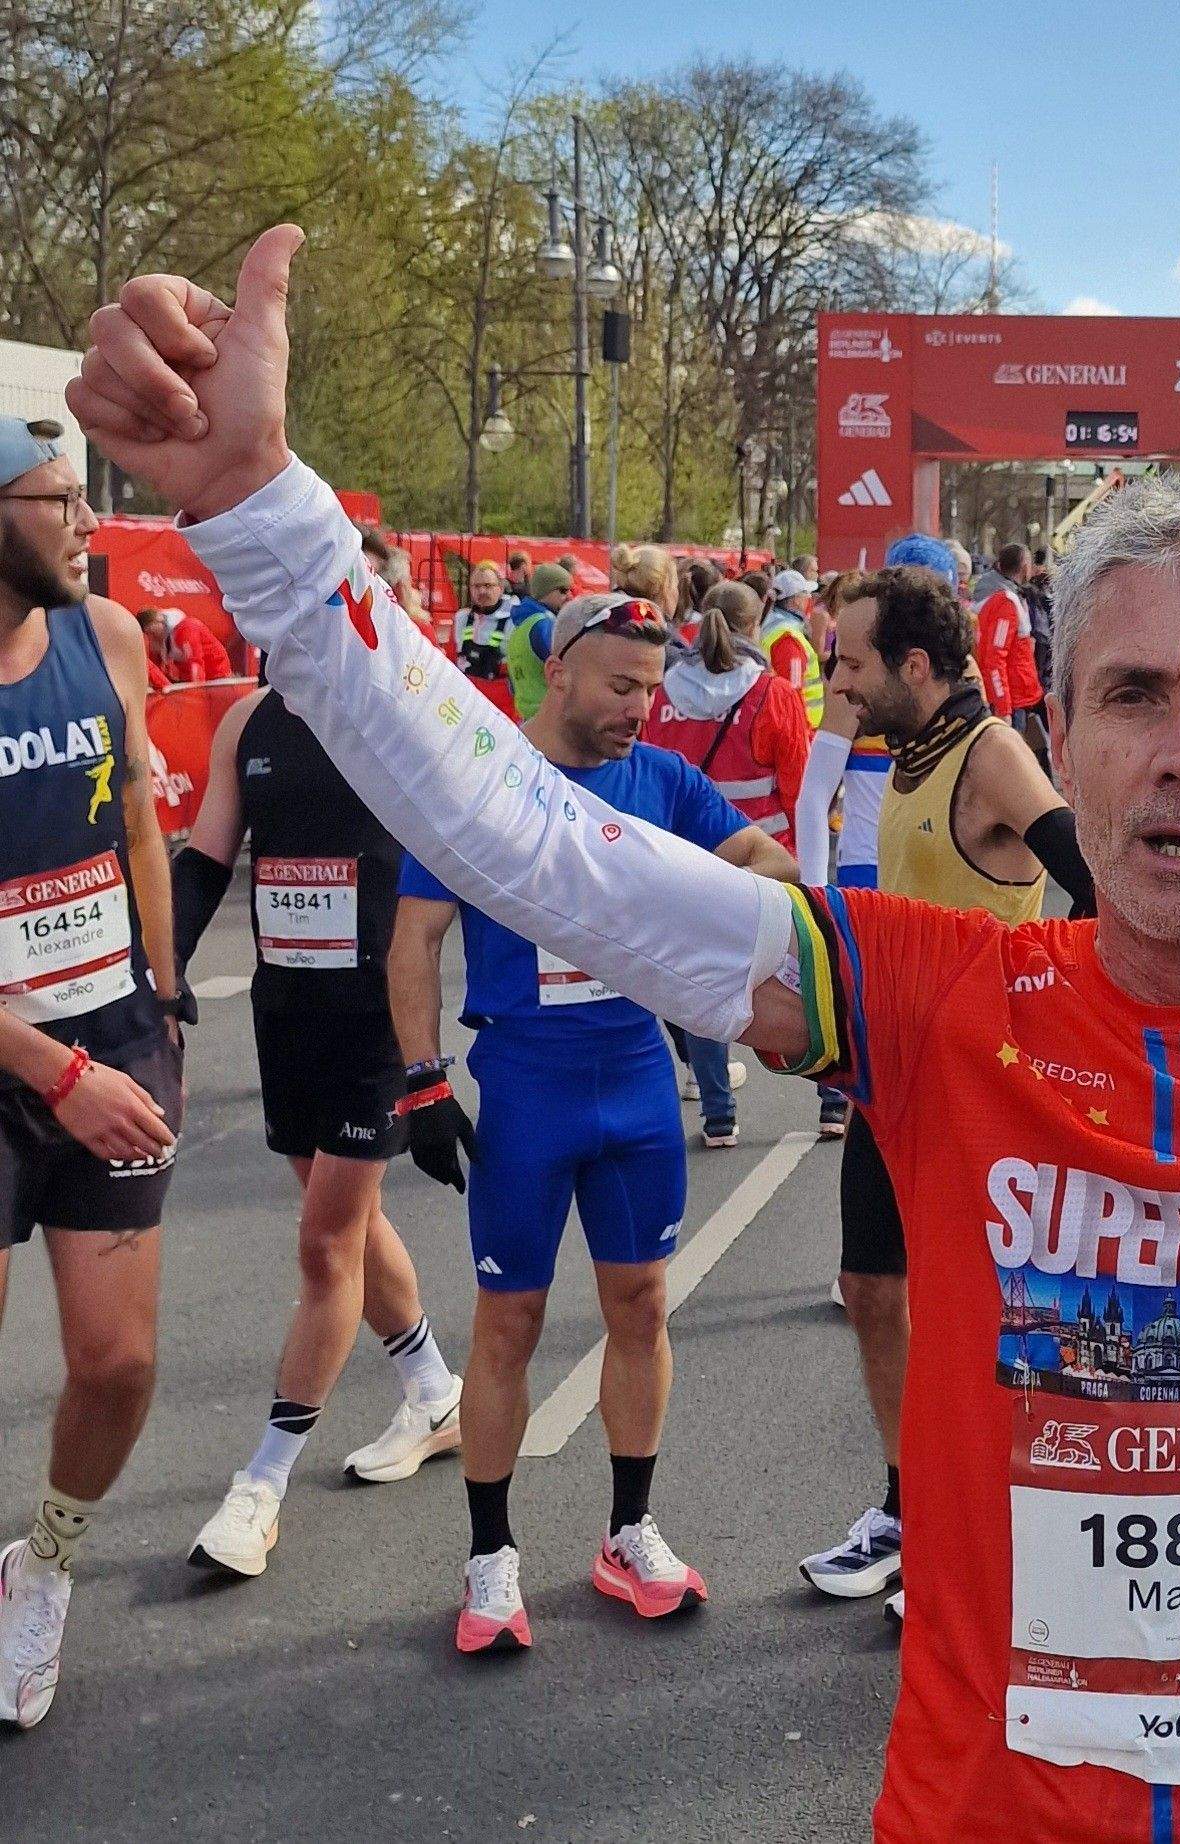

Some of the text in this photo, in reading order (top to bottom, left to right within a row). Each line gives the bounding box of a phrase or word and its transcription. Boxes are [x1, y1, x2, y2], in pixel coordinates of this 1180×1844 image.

[1026, 364, 1128, 386] GENERALI
[25, 860, 116, 904] GENERALI
[274, 864, 350, 882] GENERALI
[269, 891, 332, 910] 34841
[20, 901, 103, 941] 16454
[26, 928, 105, 959] Alexandre
[53, 981, 95, 1004] YoPRO
[1081, 1380, 1109, 1399] PRAGA
